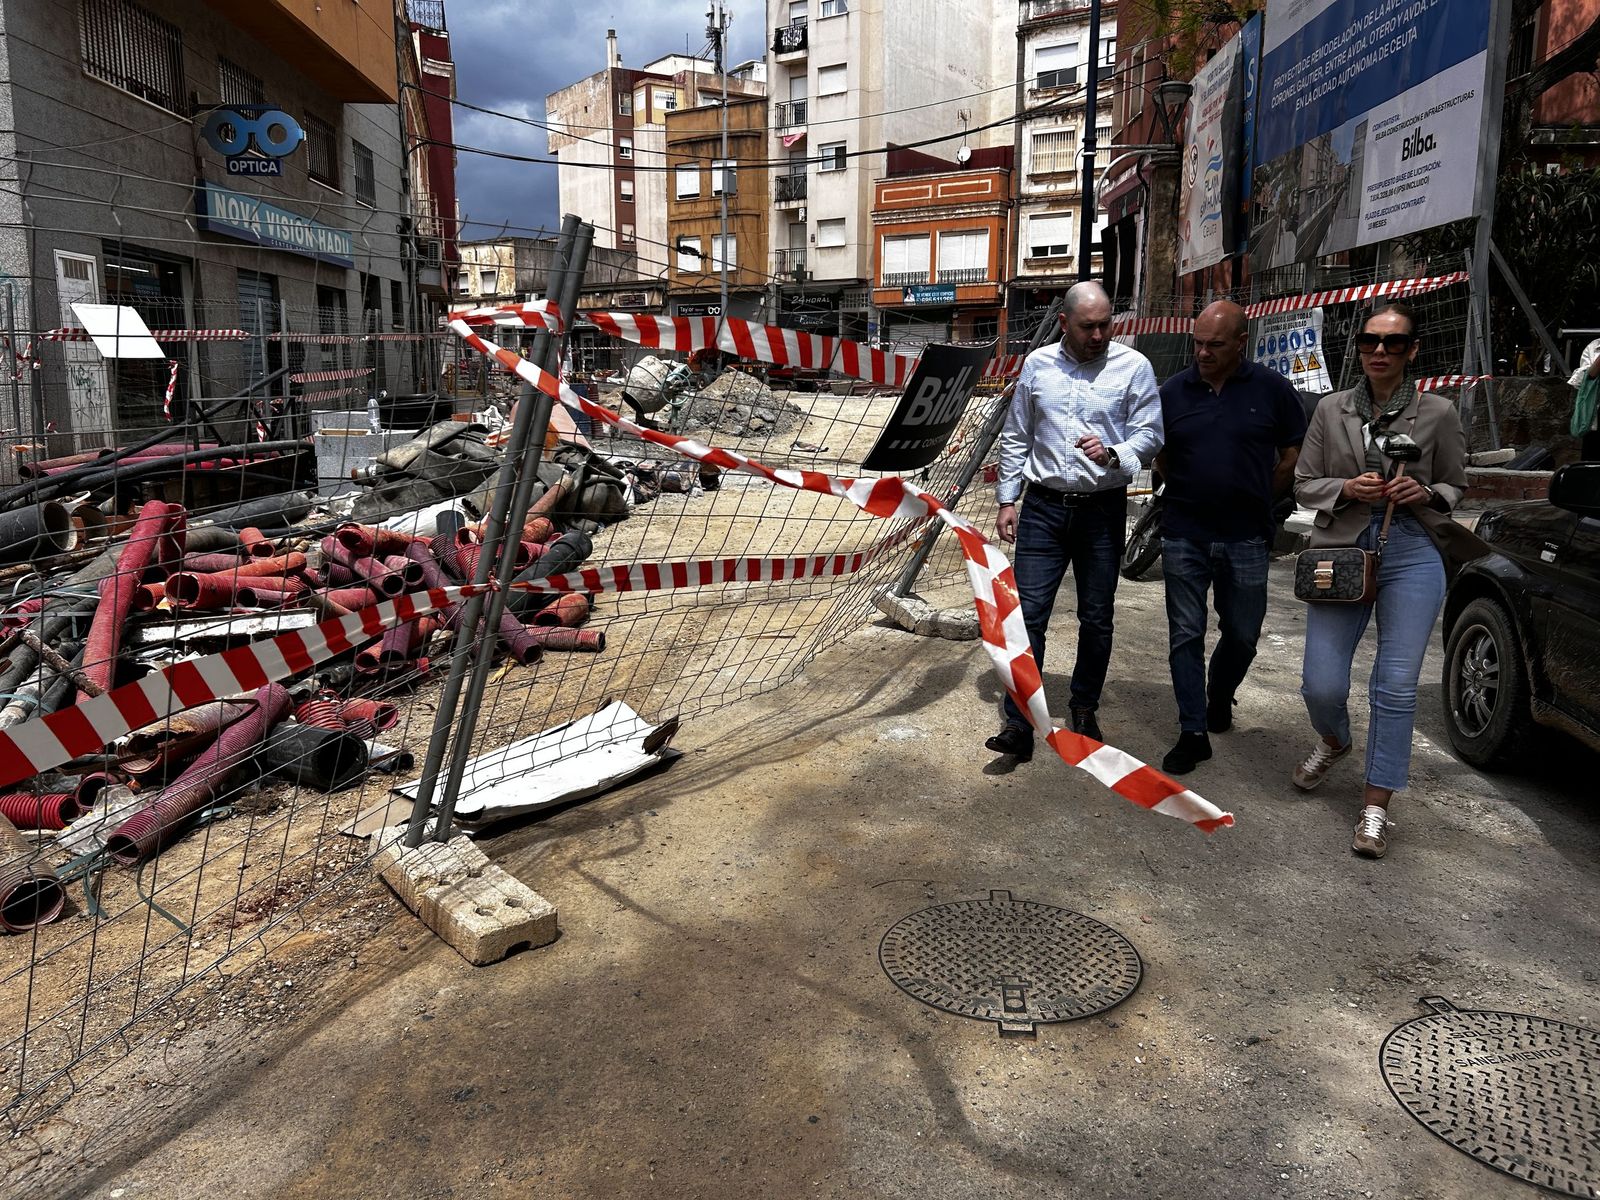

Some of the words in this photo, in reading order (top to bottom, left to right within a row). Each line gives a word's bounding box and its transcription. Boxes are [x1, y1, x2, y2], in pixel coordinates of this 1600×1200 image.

[1271, 84, 1296, 109] CORONEL
[1324, 52, 1347, 75] ENTRE
[1348, 36, 1367, 62] AVDA.
[1369, 19, 1396, 46] OTERO
[1403, 0, 1429, 24] AVDA.
[1273, 62, 1302, 91] PROYECTO
[1310, 20, 1362, 67] REMODELACIÓN
[1363, 10, 1374, 29] DE
[1374, 4, 1385, 21] LA
[1295, 97, 1304, 111] EN
[1312, 74, 1338, 100] CIUDAD
[1337, 53, 1378, 88] AUTÓNOMA
[1378, 47, 1390, 65] DE
[1389, 26, 1418, 54] CEUTA
[1423, 89, 1475, 119] INFRAESTRUCTURAS
[1401, 126, 1437, 161] Bilba.
[229, 160, 278, 173] OPTICA
[214, 192, 262, 233] NOVA
[317, 228, 350, 258] HADU
[1297, 311, 1312, 320] TODAS
[958, 925, 1054, 935] SANEAMIENTO
[1449, 1027, 1503, 1039] SOLO
[1454, 1048, 1562, 1068] SANEAMIENTO
[1530, 1160, 1600, 1184] EN124-
